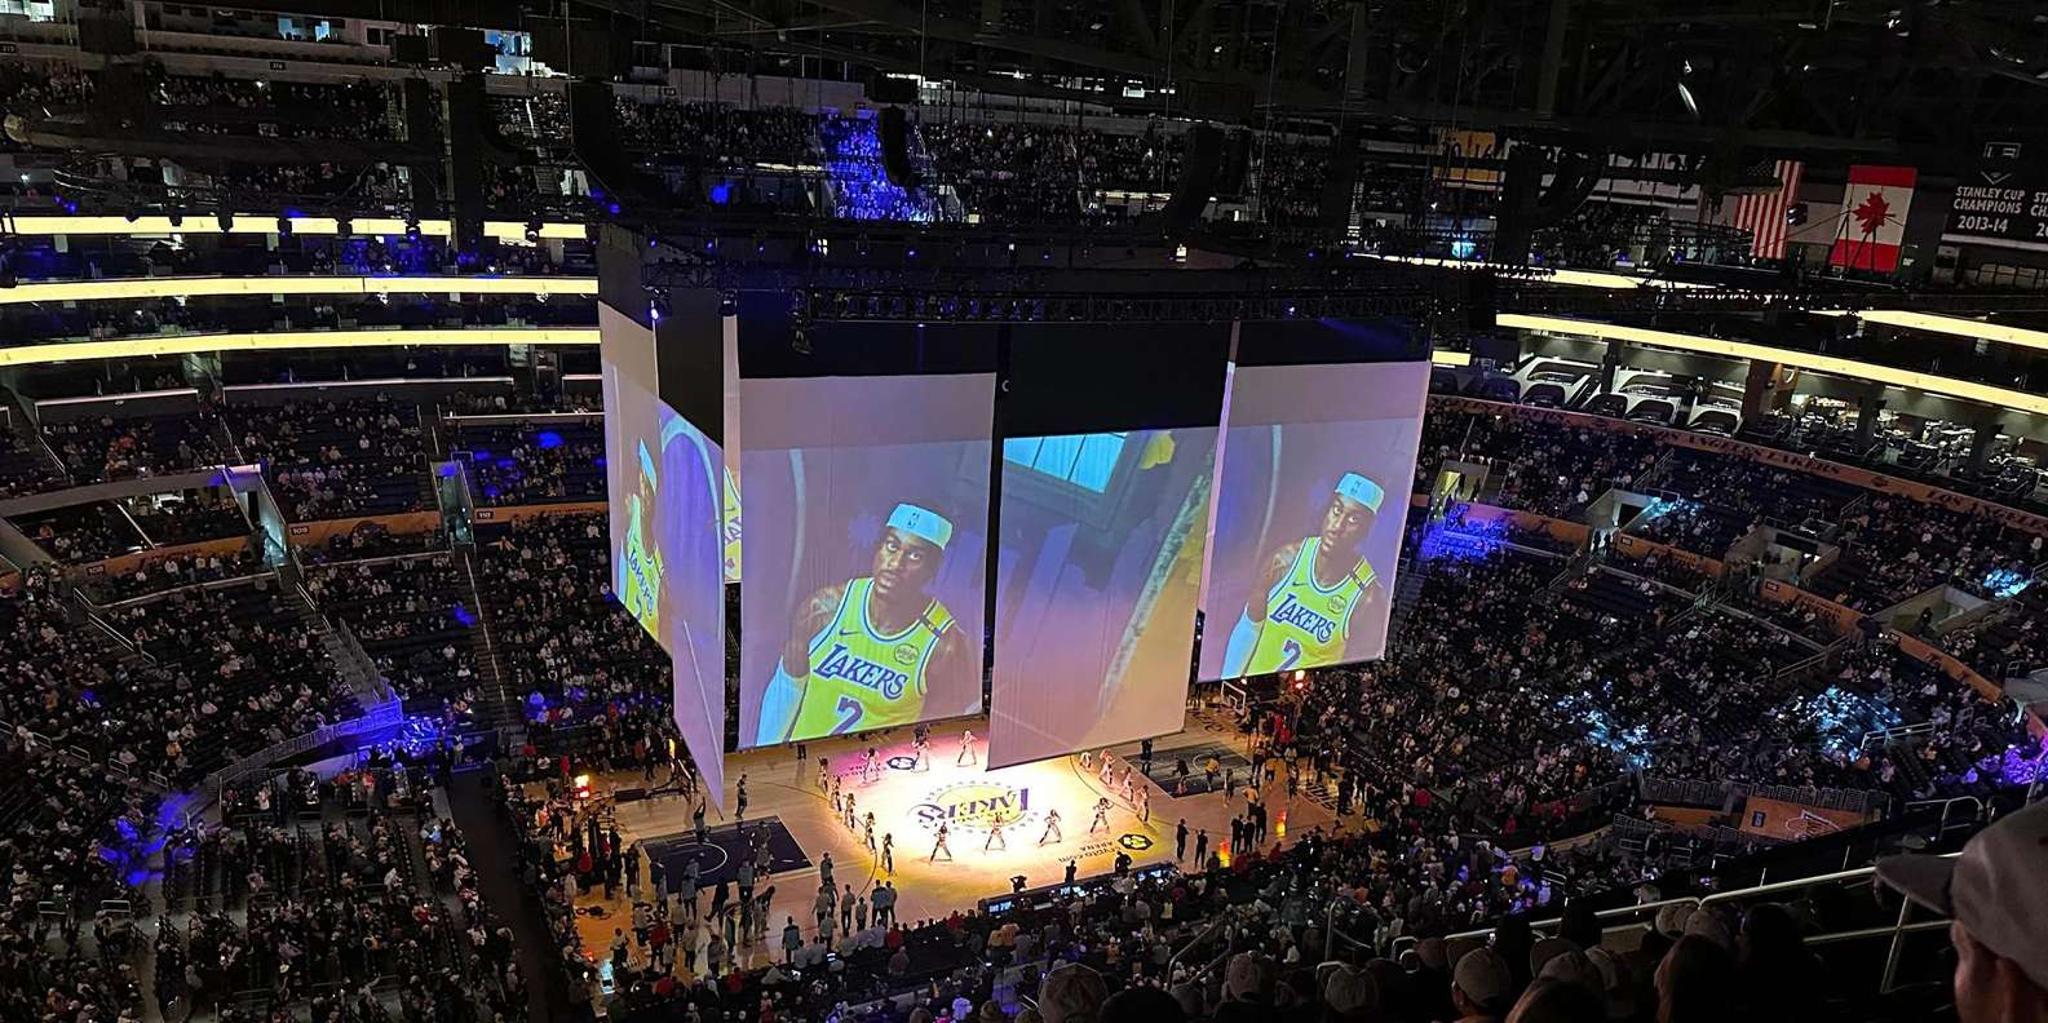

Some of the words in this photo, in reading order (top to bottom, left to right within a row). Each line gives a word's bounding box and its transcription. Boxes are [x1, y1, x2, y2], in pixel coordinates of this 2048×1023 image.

[1955, 186, 2002, 199] STANLEY
[2003, 188, 2026, 201] CUP
[1953, 198, 2023, 214] CHAMPIONS
[2030, 204, 2048, 217] CH
[1957, 215, 2009, 232] 2013-14
[1269, 593, 1337, 643] LAKERS
[1277, 640, 1302, 672] 2
[813, 643, 909, 699] LAKERS
[831, 697, 864, 735] 2
